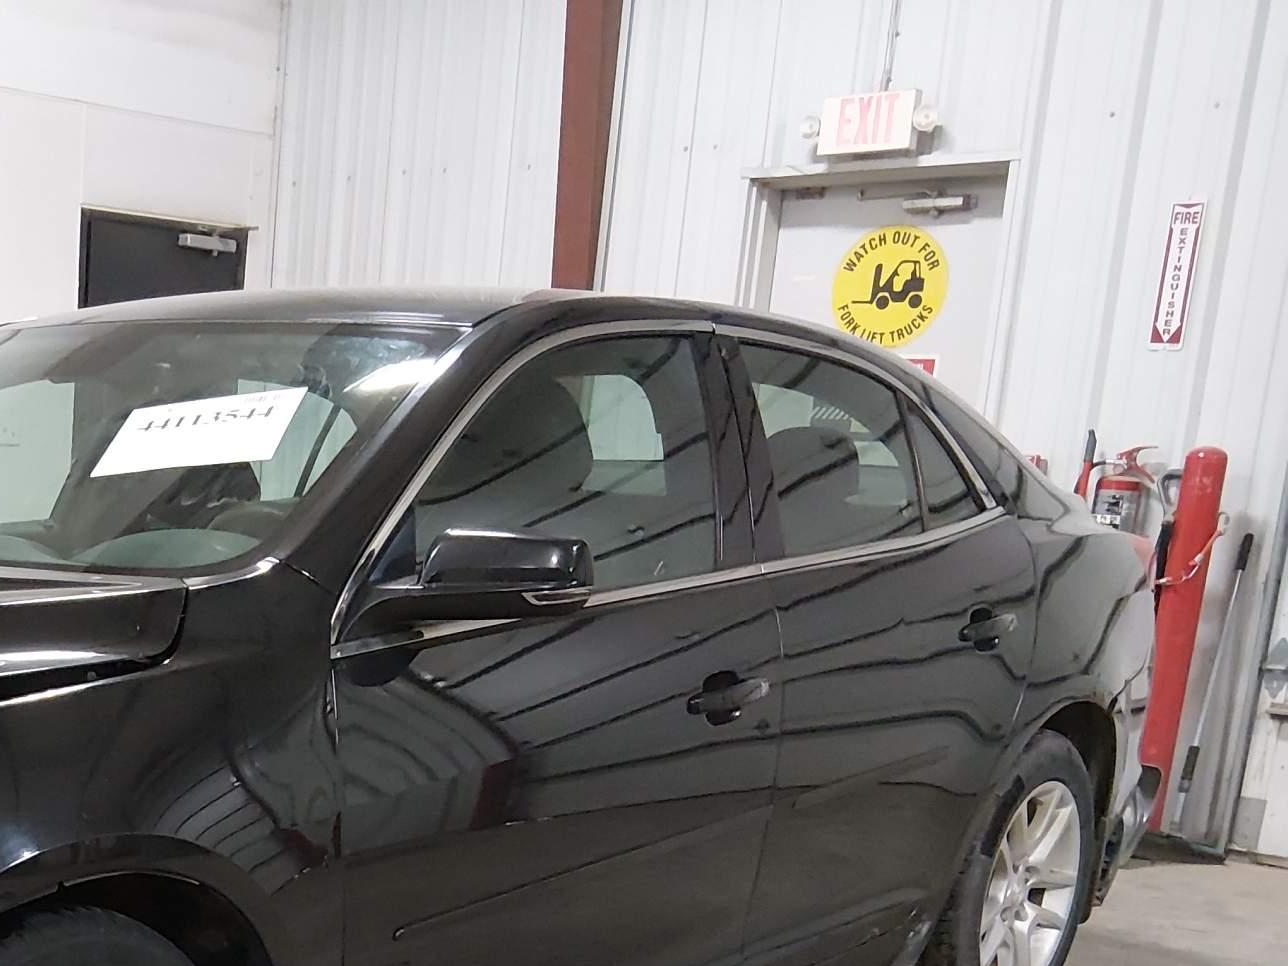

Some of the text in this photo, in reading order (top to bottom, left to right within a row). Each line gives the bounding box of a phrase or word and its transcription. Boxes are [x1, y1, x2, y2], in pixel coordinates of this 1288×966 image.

[835, 92, 900, 147] EXIT
[1173, 211, 1200, 225] FIRE
[843, 230, 940, 272] WATCH OUT FOR
[1162, 227, 1189, 336] EXTINGUISHER
[838, 304, 861, 335] FORK
[889, 304, 933, 342] TRUCKS
